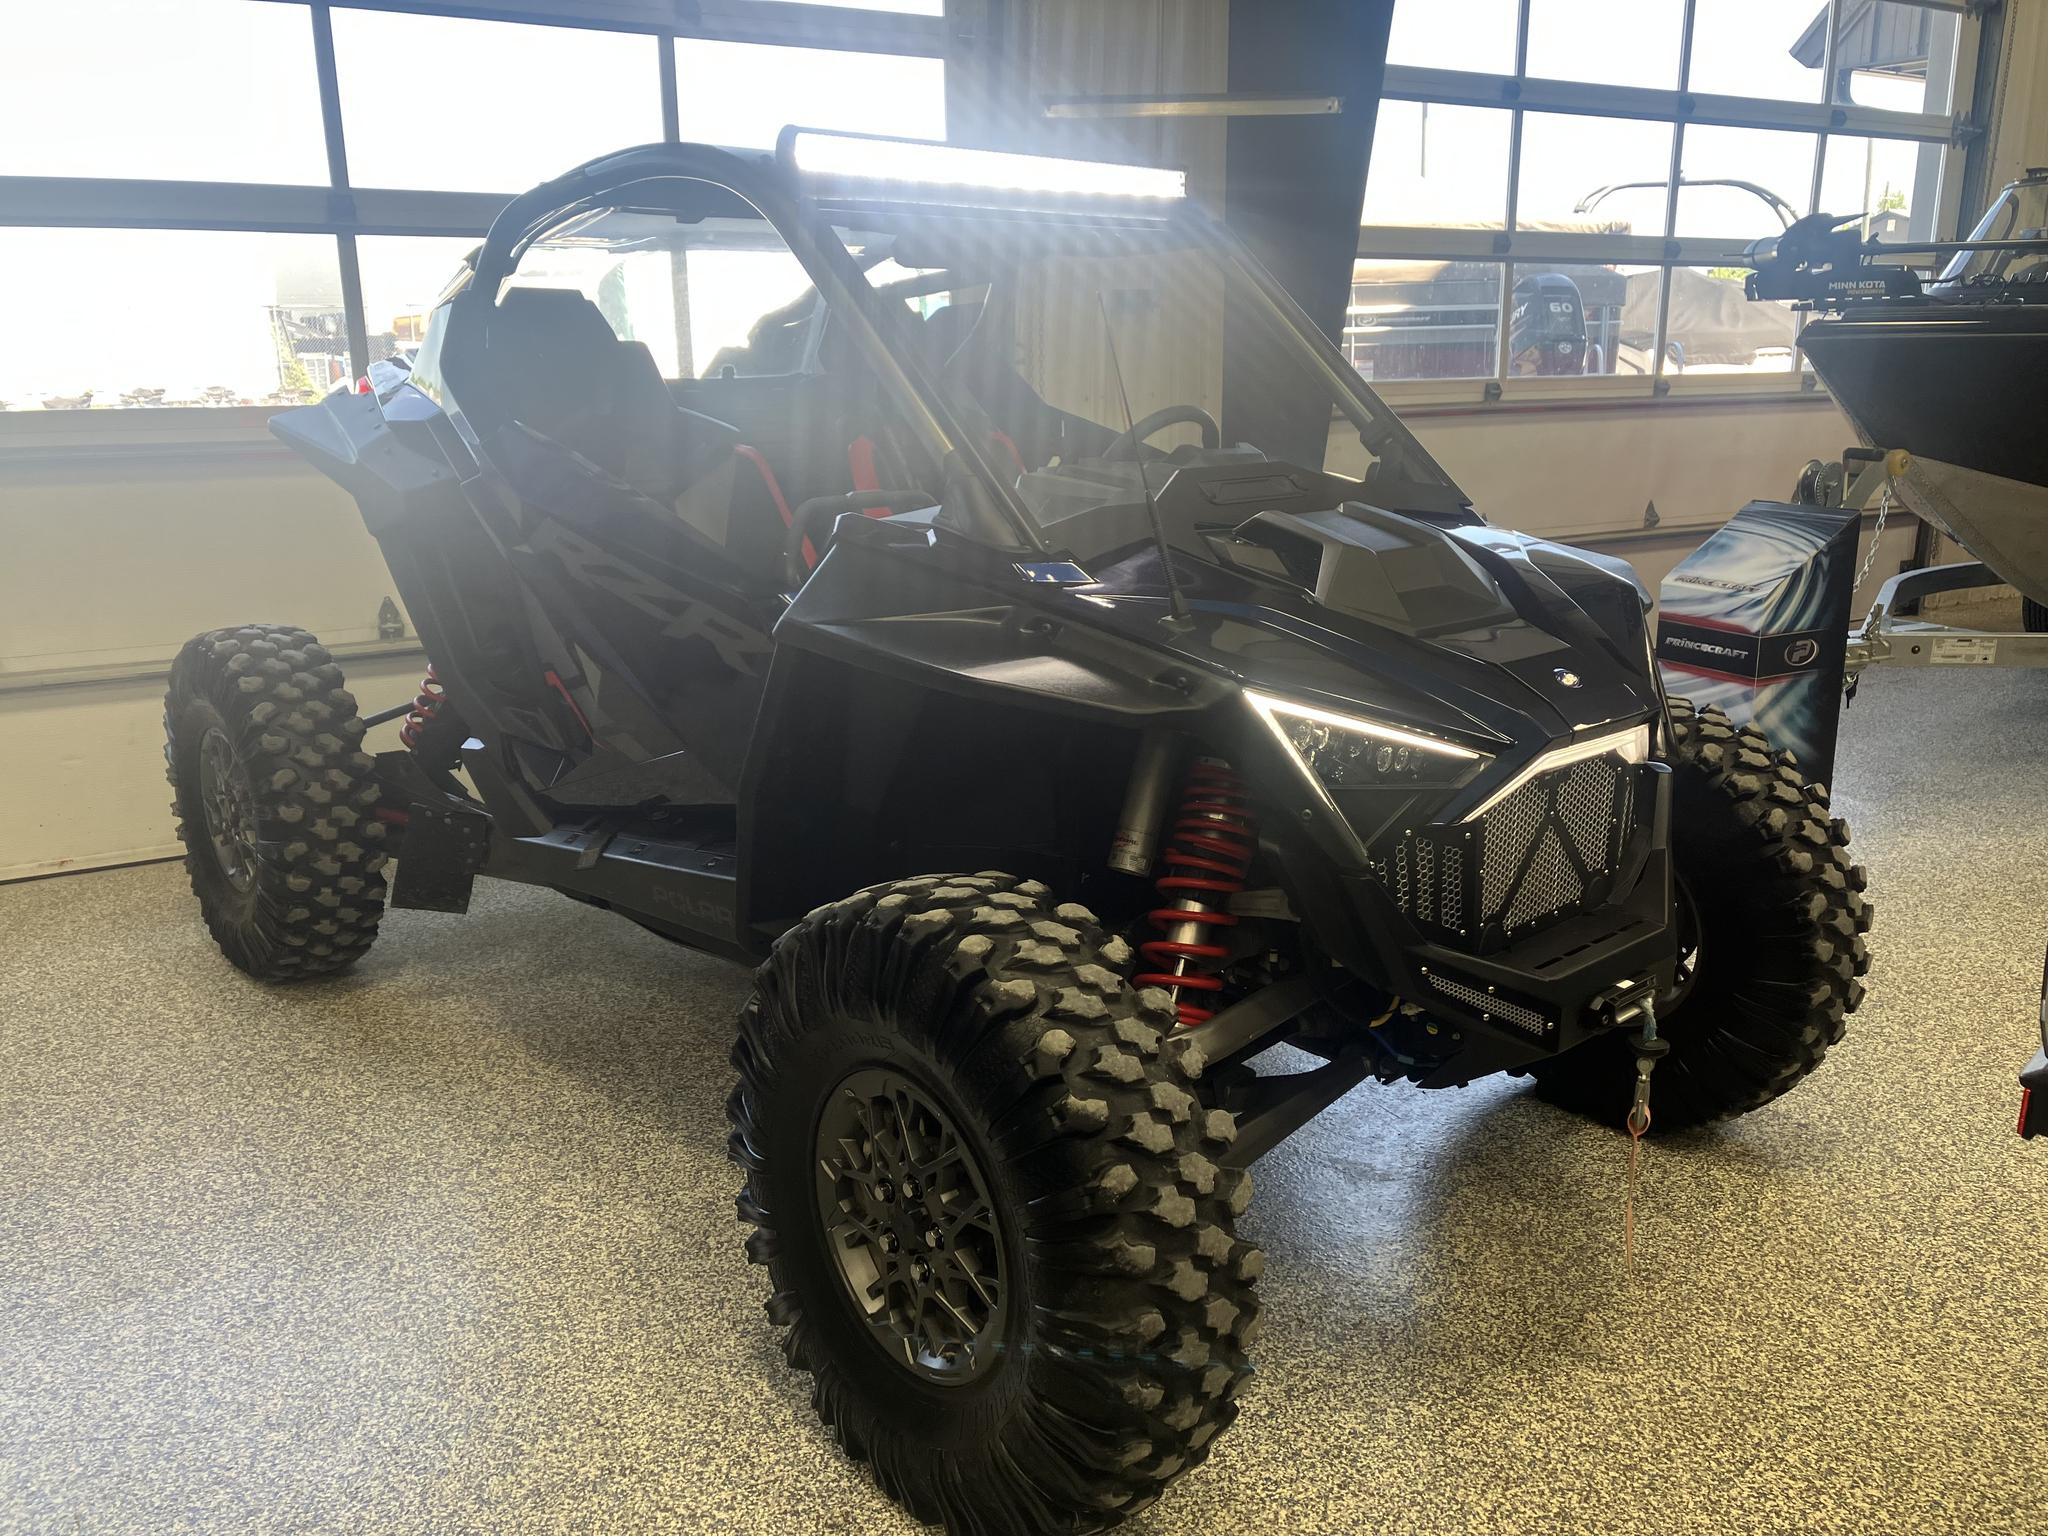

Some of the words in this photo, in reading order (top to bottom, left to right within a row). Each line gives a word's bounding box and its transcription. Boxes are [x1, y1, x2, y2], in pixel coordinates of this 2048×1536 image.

[1829, 281, 1857, 290] MINN
[1859, 280, 1886, 289] KOTA
[1549, 302, 1573, 313] 60
[1664, 636, 1749, 660] PRINCECRAFT
